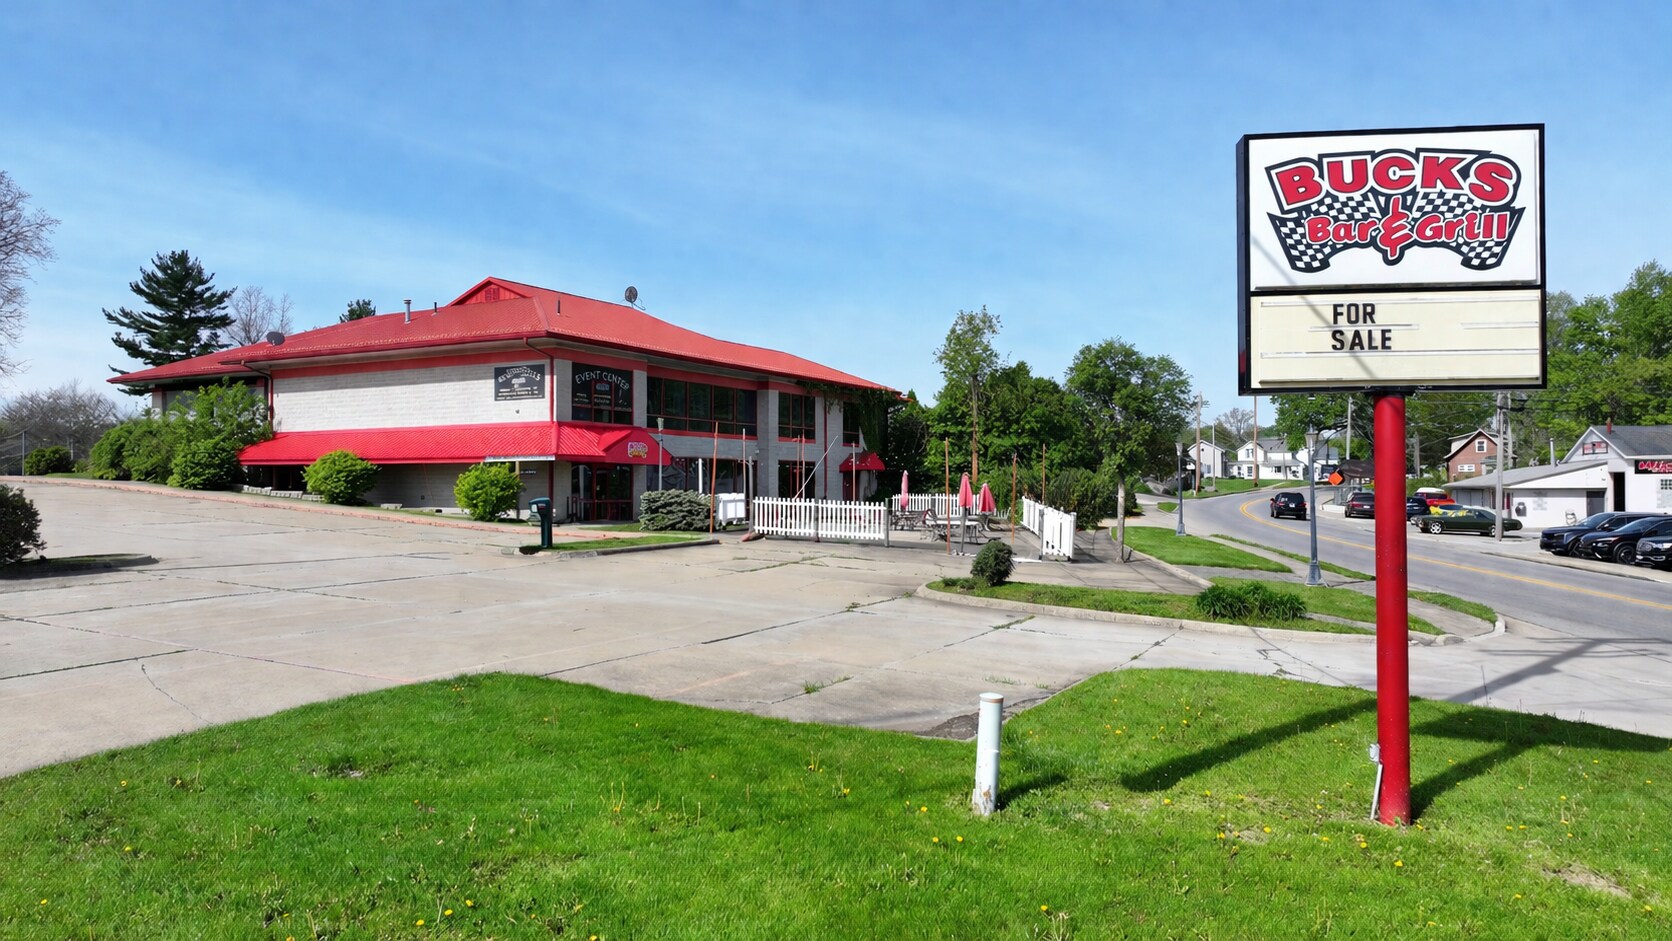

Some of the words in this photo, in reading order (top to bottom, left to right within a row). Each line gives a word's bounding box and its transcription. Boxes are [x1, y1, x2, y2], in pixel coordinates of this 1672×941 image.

[1273, 154, 1515, 206] BUCKS
[1306, 215, 1377, 244] Bar
[1379, 196, 1412, 258] &
[1414, 212, 1510, 241] Grill
[1332, 303, 1376, 325] FOR
[1331, 329, 1392, 351] SALE
[575, 370, 601, 385] EVENT
[602, 372, 630, 391] CENTER
